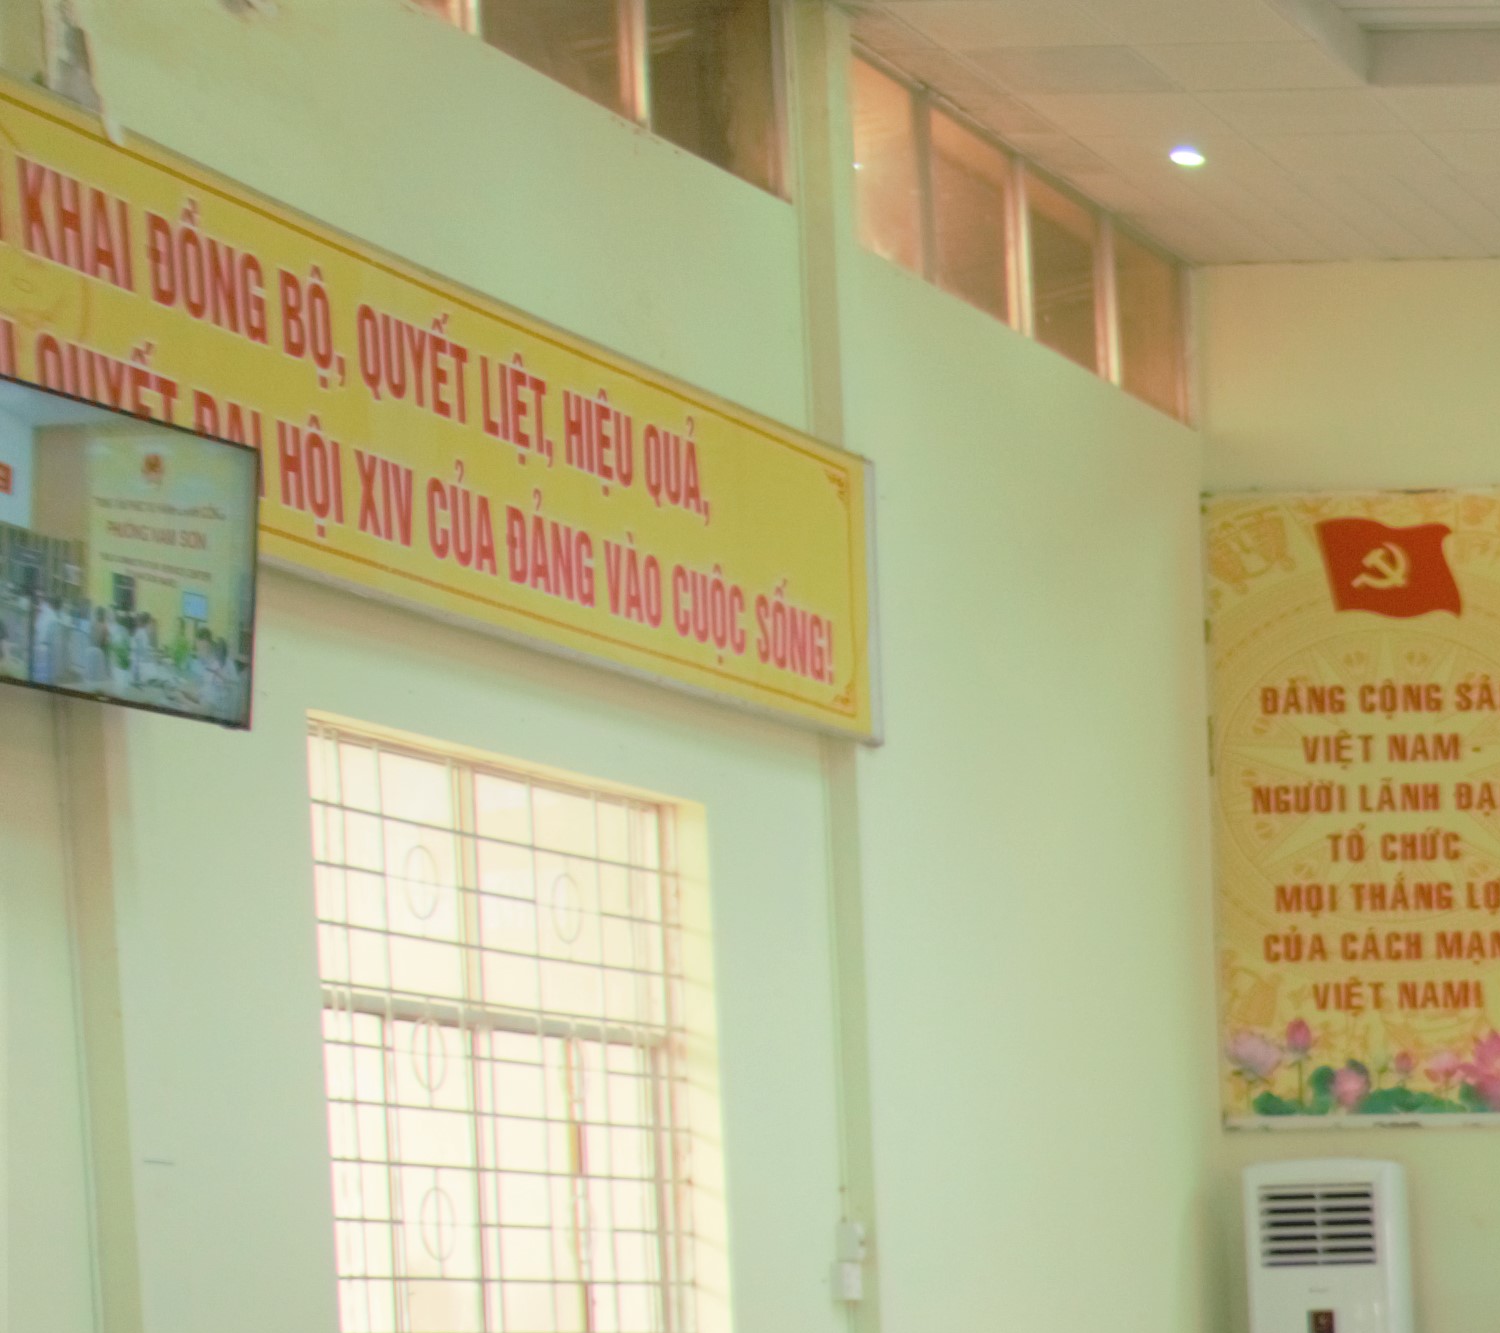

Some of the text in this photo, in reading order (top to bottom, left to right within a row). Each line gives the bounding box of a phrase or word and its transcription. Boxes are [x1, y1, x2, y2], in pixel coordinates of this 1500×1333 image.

[16, 152, 135, 293] KHAI
[146, 197, 269, 345] ĐỒNG
[278, 264, 346, 390] BỘ,
[356, 303, 468, 425] QUYẾT
[479, 352, 554, 468] LIỆT,
[563, 387, 634, 497] HIỆU
[643, 415, 710, 526] QUẢ,
[277, 413, 345, 538] HỘI
[353, 448, 413, 547] XIV
[426, 458, 498, 577] CỦA
[506, 488, 596, 609] ĐẢNG
[602, 531, 662, 629] VÀO
[672, 562, 747, 666] CUỘC
[755, 578, 835, 686] SỐNG!
[1260, 677, 1347, 716] ĐẢNG
[1358, 679, 1444, 720] CỘNG
[1301, 729, 1374, 771] VIỆT
[1387, 733, 1461, 763] NAM
[1251, 778, 1346, 815] NGƯỜI
[1359, 777, 1441, 812] LÃNH
[1380, 827, 1462, 862] CHỨC
[1274, 884, 1338, 918] MỌI
[1349, 871, 1454, 912] THẮNG
[1263, 925, 1330, 964] CỦA
[1340, 927, 1424, 961] CÁCH
[1311, 976, 1386, 1017] VIỆT
